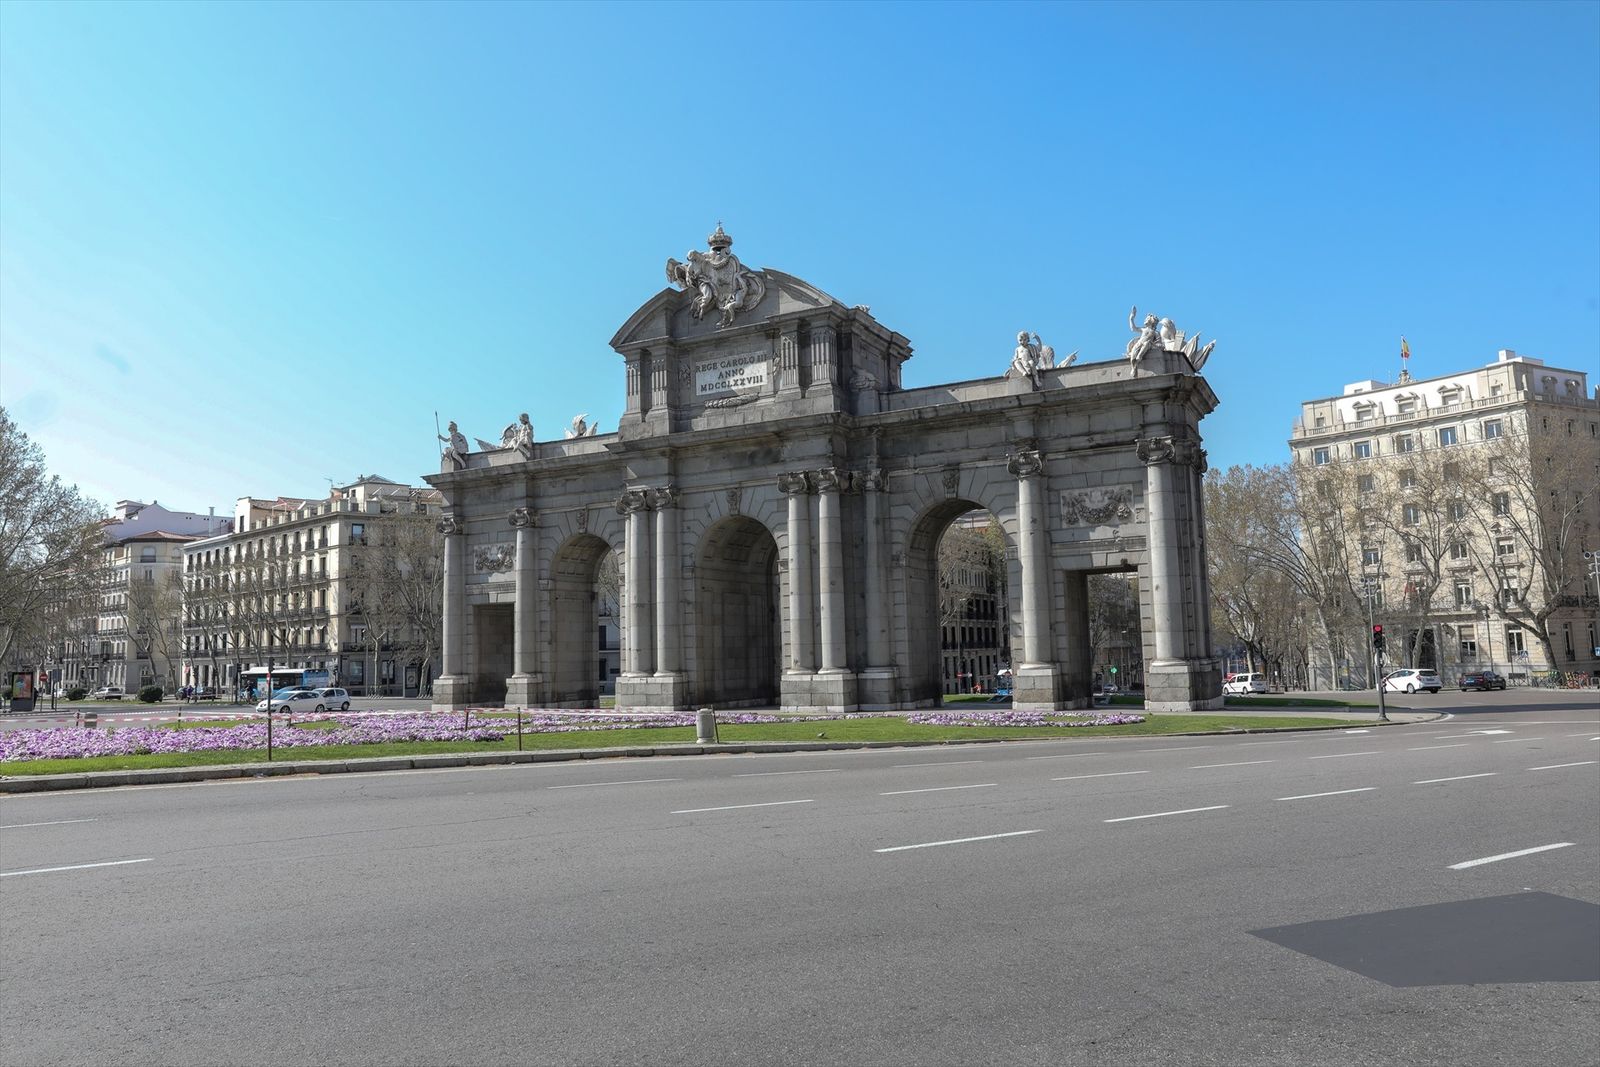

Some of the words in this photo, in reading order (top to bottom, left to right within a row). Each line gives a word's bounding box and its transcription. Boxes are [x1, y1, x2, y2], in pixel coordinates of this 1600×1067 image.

[696, 363, 718, 373] REGE
[720, 357, 755, 368] CAROLO
[757, 354, 767, 362] III
[718, 368, 745, 379] ANNO
[700, 375, 763, 392] MDCCLXXVIII
